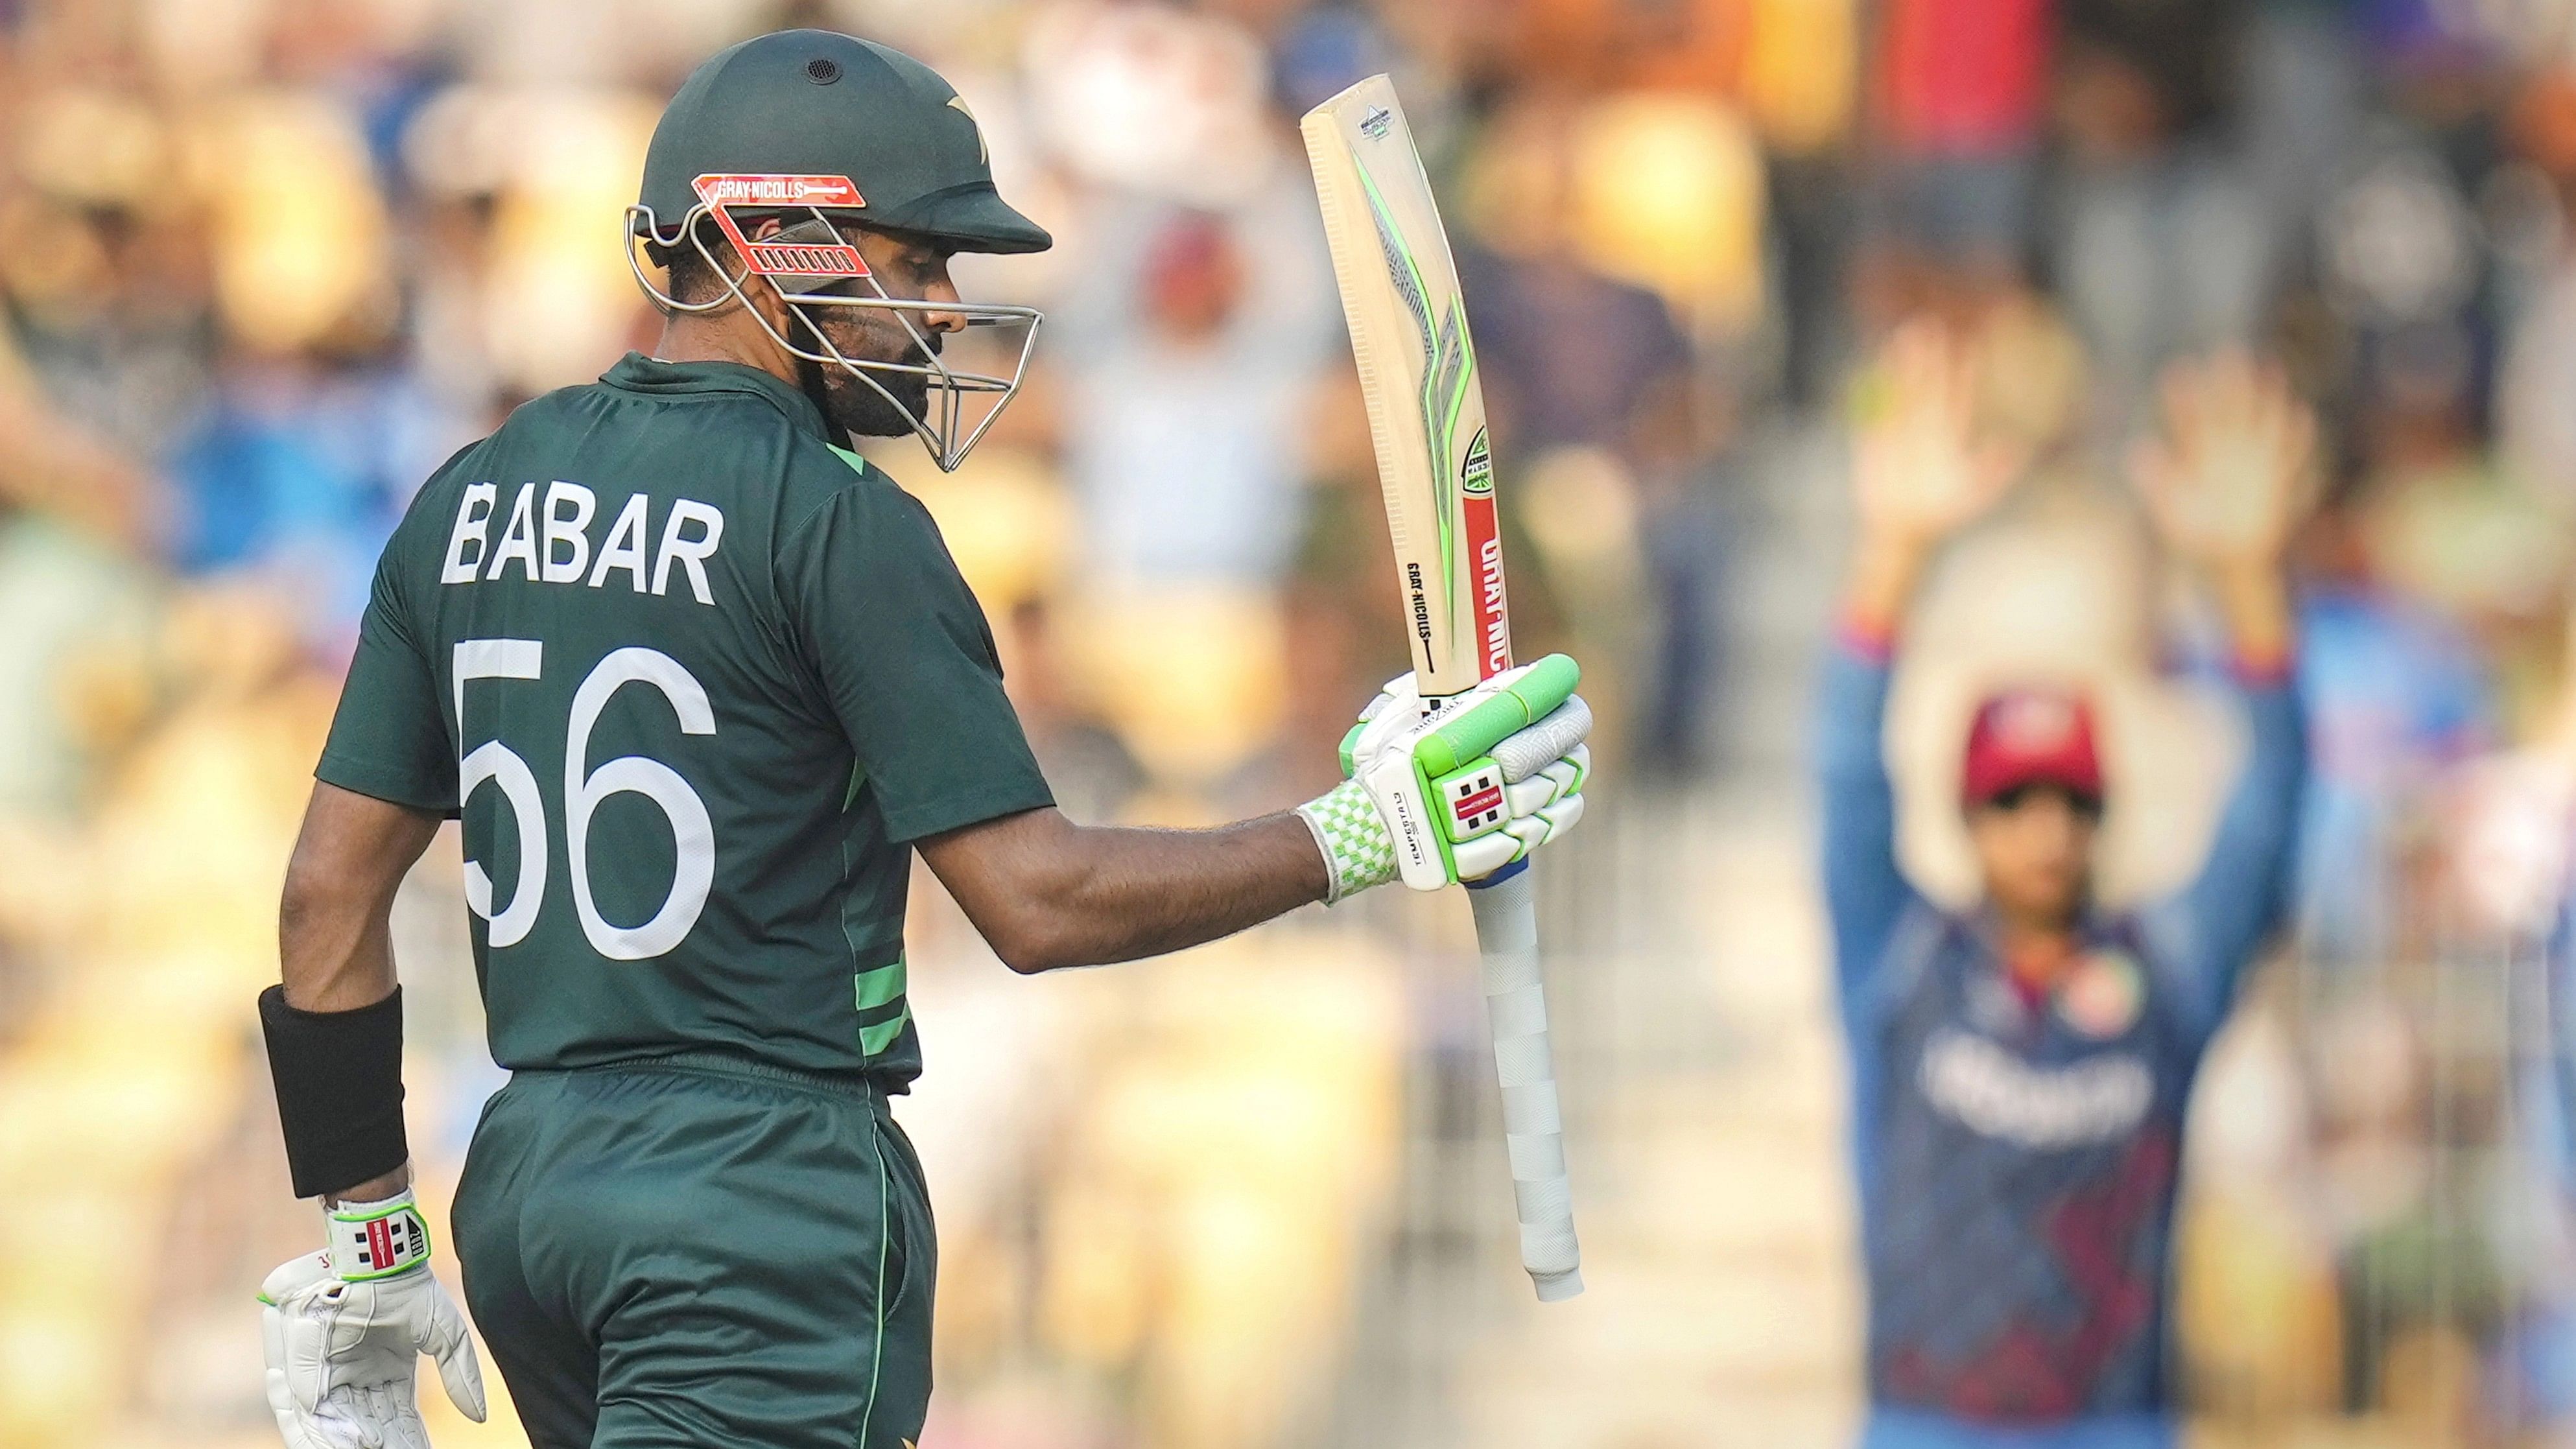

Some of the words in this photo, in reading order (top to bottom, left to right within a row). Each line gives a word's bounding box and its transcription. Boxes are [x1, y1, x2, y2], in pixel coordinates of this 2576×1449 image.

[718, 181, 805, 199] GRAY-NICOLLS
[441, 481, 725, 606] BABAR
[1407, 563, 1431, 639] GRAY-NICOLLS
[453, 638, 717, 961] 56
